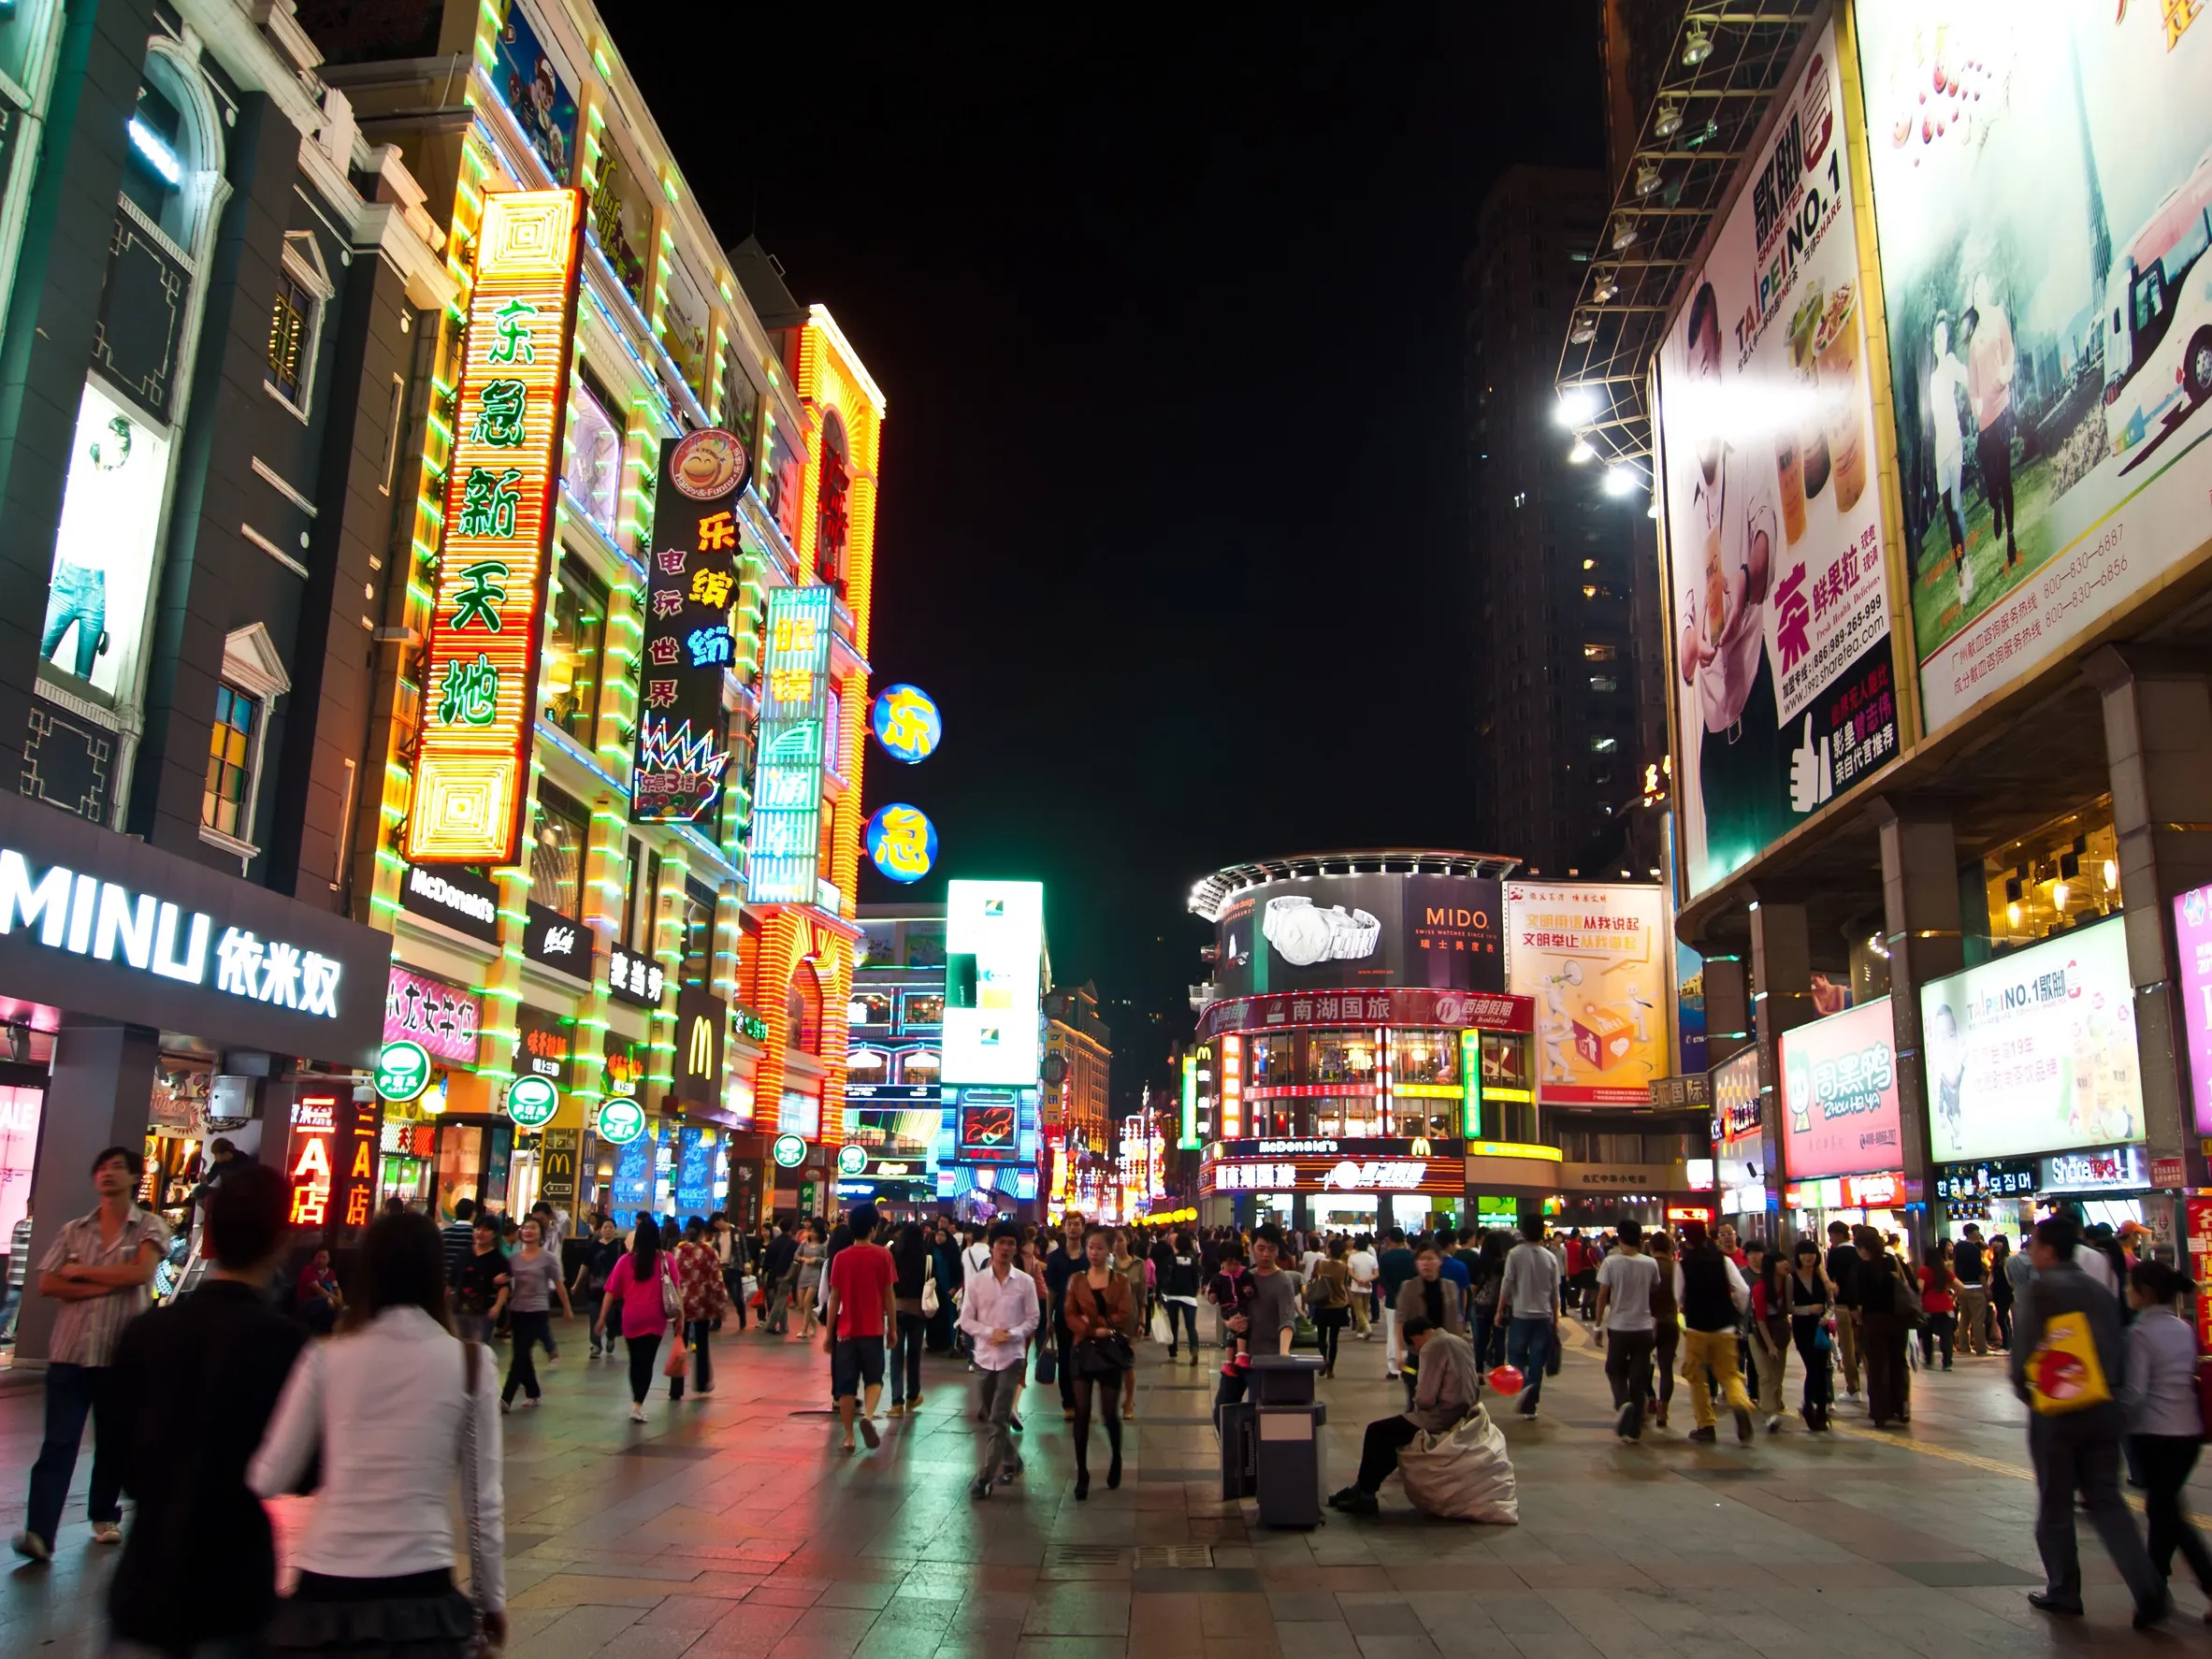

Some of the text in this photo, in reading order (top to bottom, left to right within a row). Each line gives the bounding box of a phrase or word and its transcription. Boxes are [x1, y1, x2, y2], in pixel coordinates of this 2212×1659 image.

[1735, 148, 1842, 352] TAIPEI NO.1
[1758, 182, 1804, 268] SHARE TEA
[440, 298, 541, 727] 东急新天地
[674, 472, 735, 498] Happy&Funny
[687, 510, 736, 668] 乐缤纷
[1774, 542, 1859, 677] 茶 鲜果粒
[1816, 575, 1881, 643] Fresh Health Delicious
[648, 547, 687, 709] 电玩世界
[772, 616, 817, 702] 眼镜
[1951, 591, 2039, 671] 广州献血咨询服务热线
[1954, 618, 2043, 696] 成分献血咨询服务热线
[1832, 690, 1893, 759] 影皇曾志伟
[1835, 723, 1895, 787] 亲自代言推荐
[410, 867, 495, 924] McDonald's
[1425, 907, 1488, 930] MIDO
[1525, 914, 1640, 931] 文明用语从我说起
[216, 926, 341, 1018] 依米奴
[1420, 938, 1495, 954] 瑞士美度表
[1523, 932, 1638, 950] 文明举止从我做起
[610, 952, 665, 1008] 麦当劳
[1293, 997, 1391, 1022] 南湖国旅
[1462, 998, 1513, 1017] 西部假期
[2004, 978, 2039, 1009] NO.1
[1478, 1016, 1508, 1026] holiday
[1814, 1041, 1893, 1105] 周黑鸭
[1824, 1100, 1848, 1120] ZHOU
[1259, 1140, 1337, 1153] McDonald's
